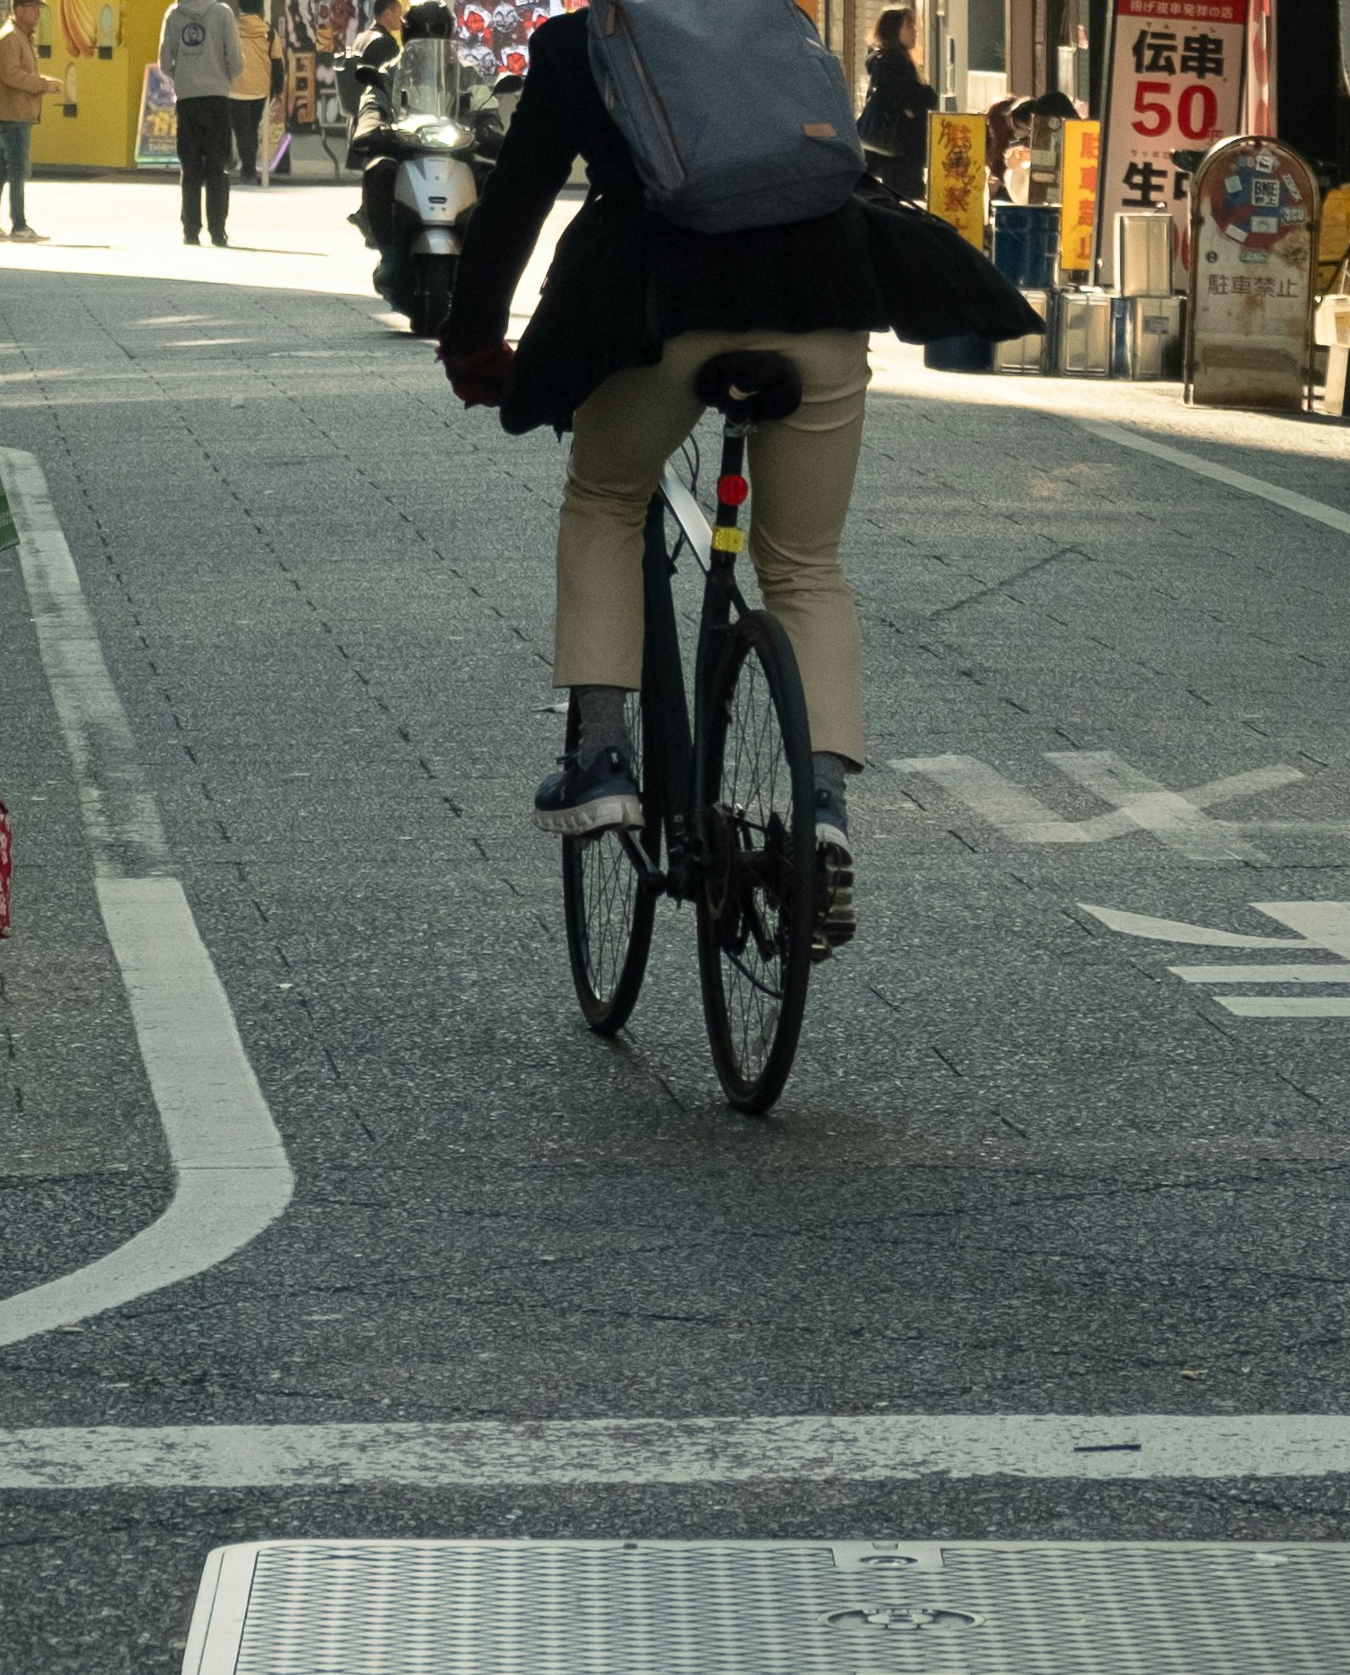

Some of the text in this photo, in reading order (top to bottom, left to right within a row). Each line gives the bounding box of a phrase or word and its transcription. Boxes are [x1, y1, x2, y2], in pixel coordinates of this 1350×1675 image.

[1131, 28, 1226, 80] 伝串
[1130, 80, 1219, 141] 50
[1207, 273, 1301, 299] 駐車禁止
